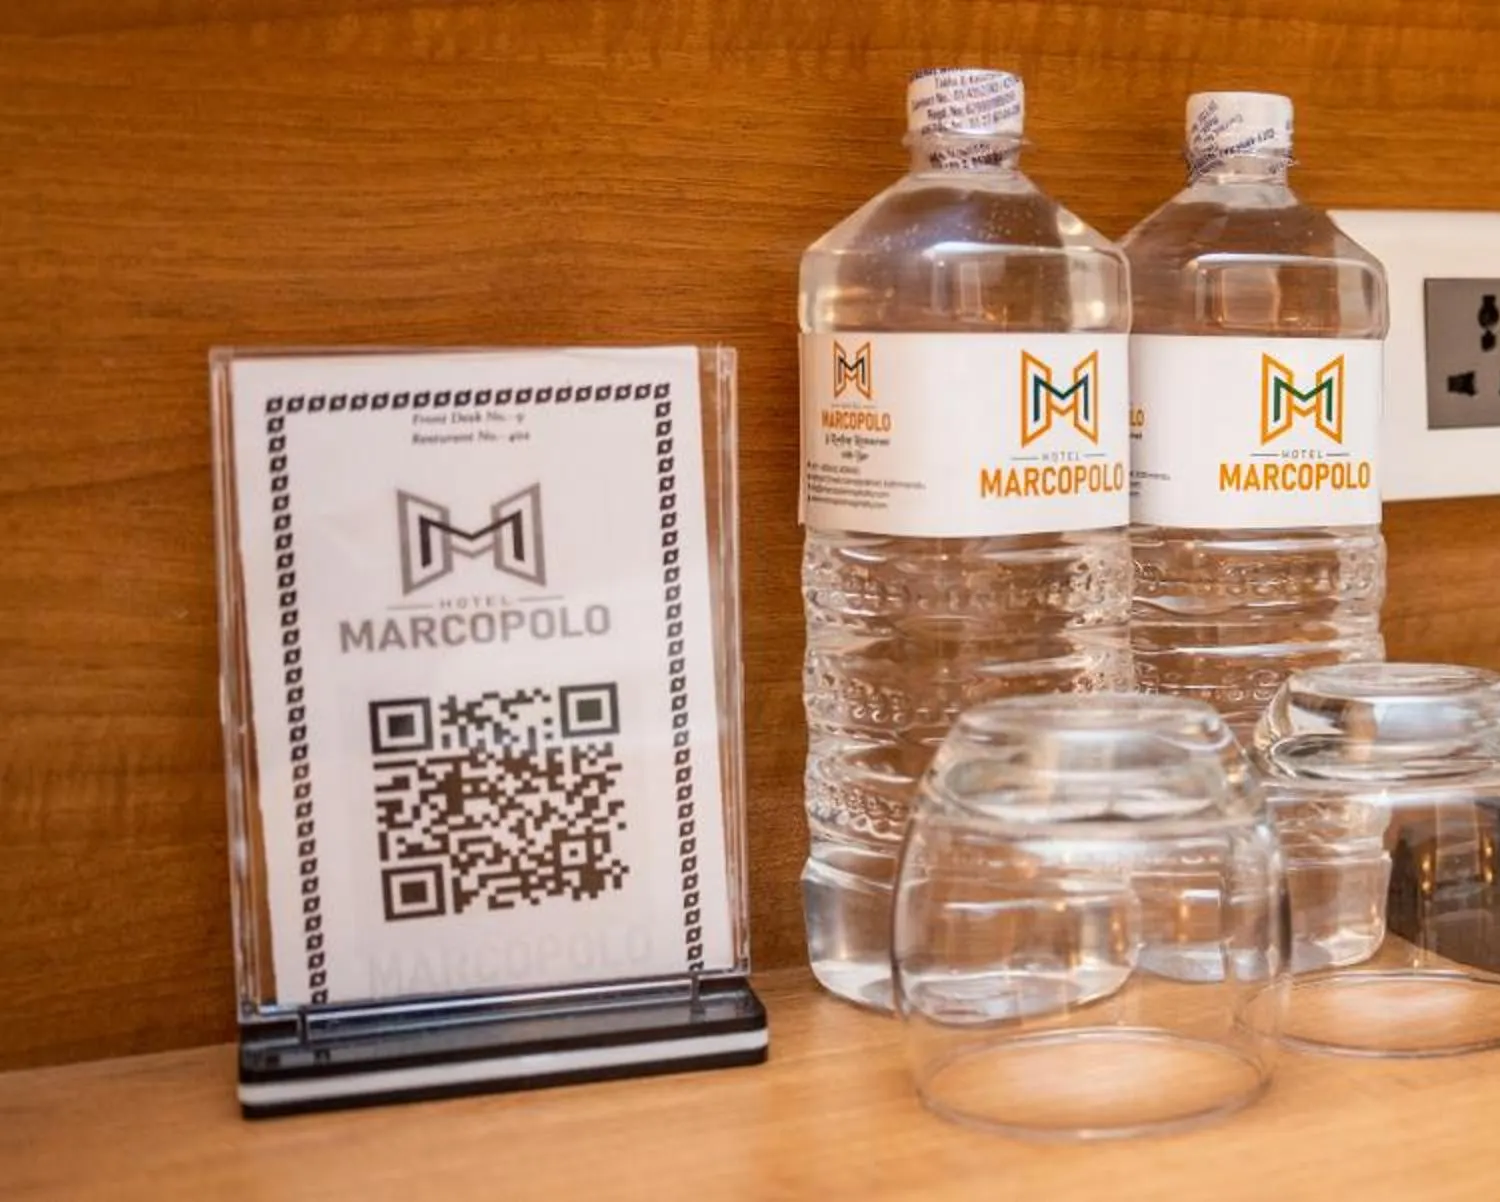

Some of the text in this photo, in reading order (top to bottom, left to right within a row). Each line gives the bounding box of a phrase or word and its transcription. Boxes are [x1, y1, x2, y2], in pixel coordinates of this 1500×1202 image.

[821, 410, 891, 432] MARCOPOLO
[1041, 451, 1081, 462] HOTEL
[1281, 450, 1324, 459] HOTEL
[980, 463, 1124, 499] MARCOPOLO
[1219, 462, 1371, 491] MARCOPOLO
[439, 595, 512, 610] HOTEL
[339, 604, 612, 654] MARCOPOLO
